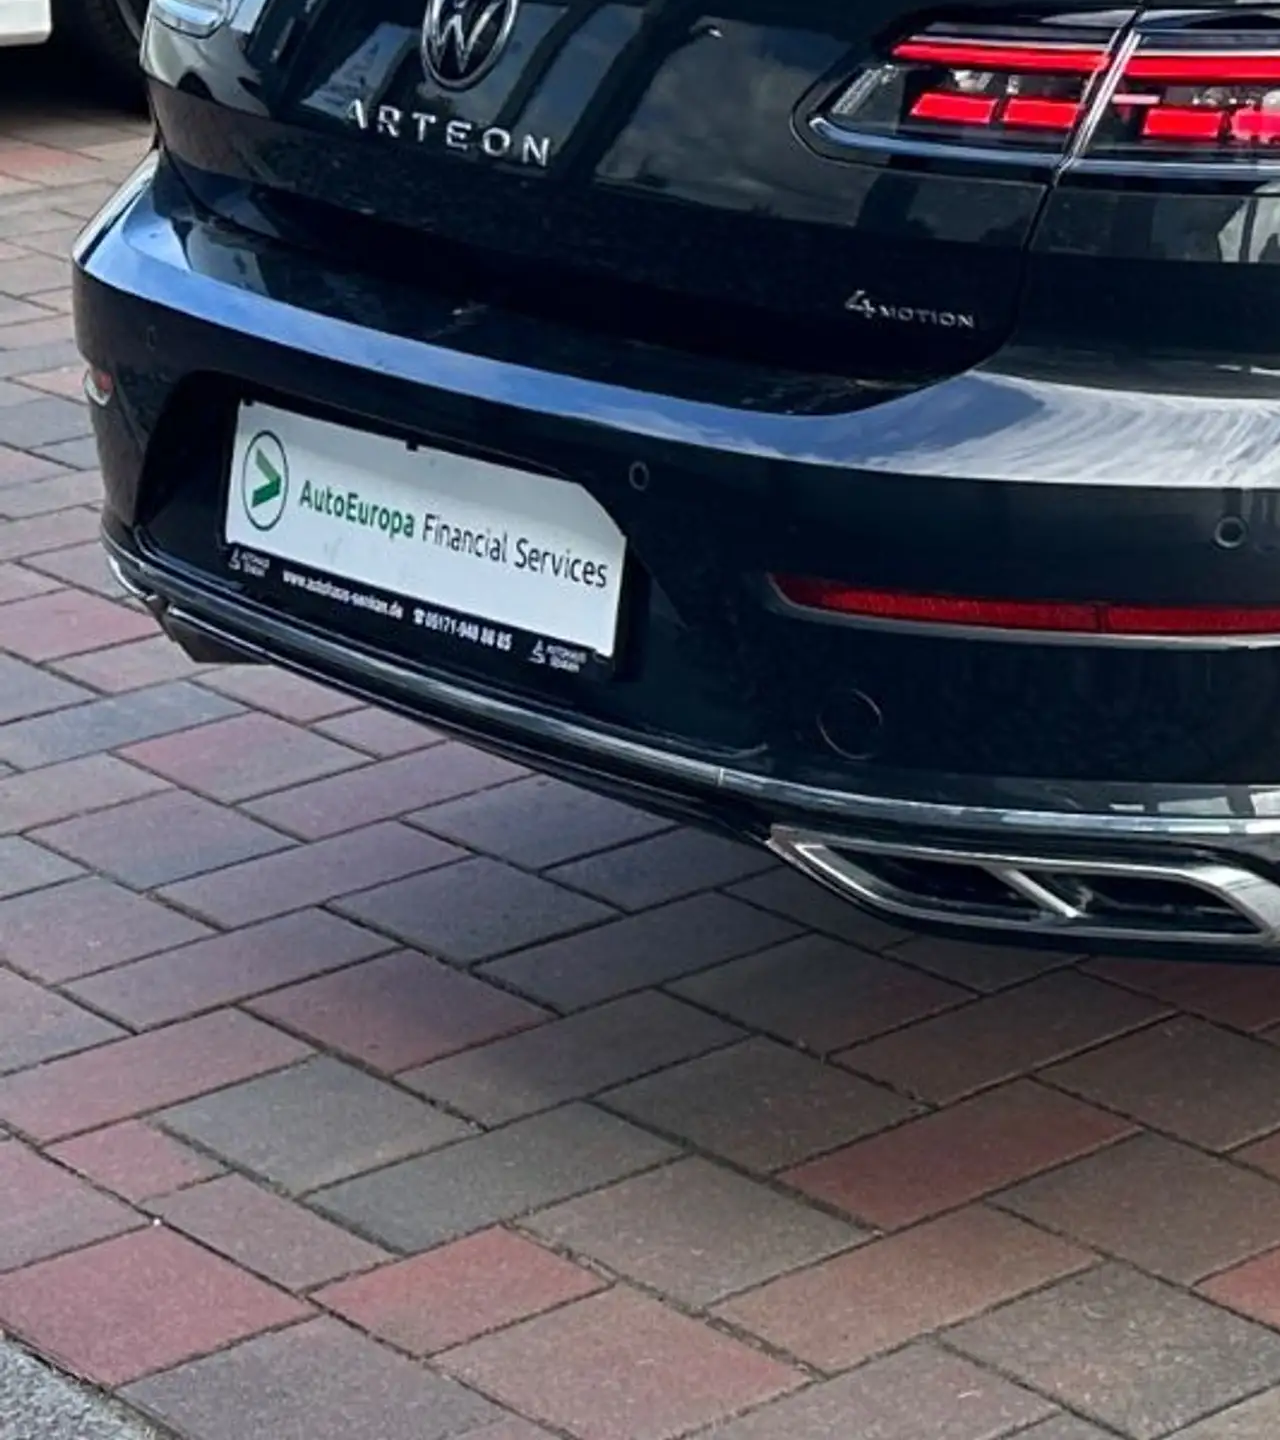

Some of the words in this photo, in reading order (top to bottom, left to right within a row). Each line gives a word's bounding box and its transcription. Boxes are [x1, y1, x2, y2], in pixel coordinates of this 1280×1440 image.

[347, 98, 550, 167] ARTEON
[844, 289, 975, 329] 4MOTION
[299, 479, 416, 542] AutoEuropa
[422, 513, 508, 563] Financial
[513, 537, 608, 589] Services
